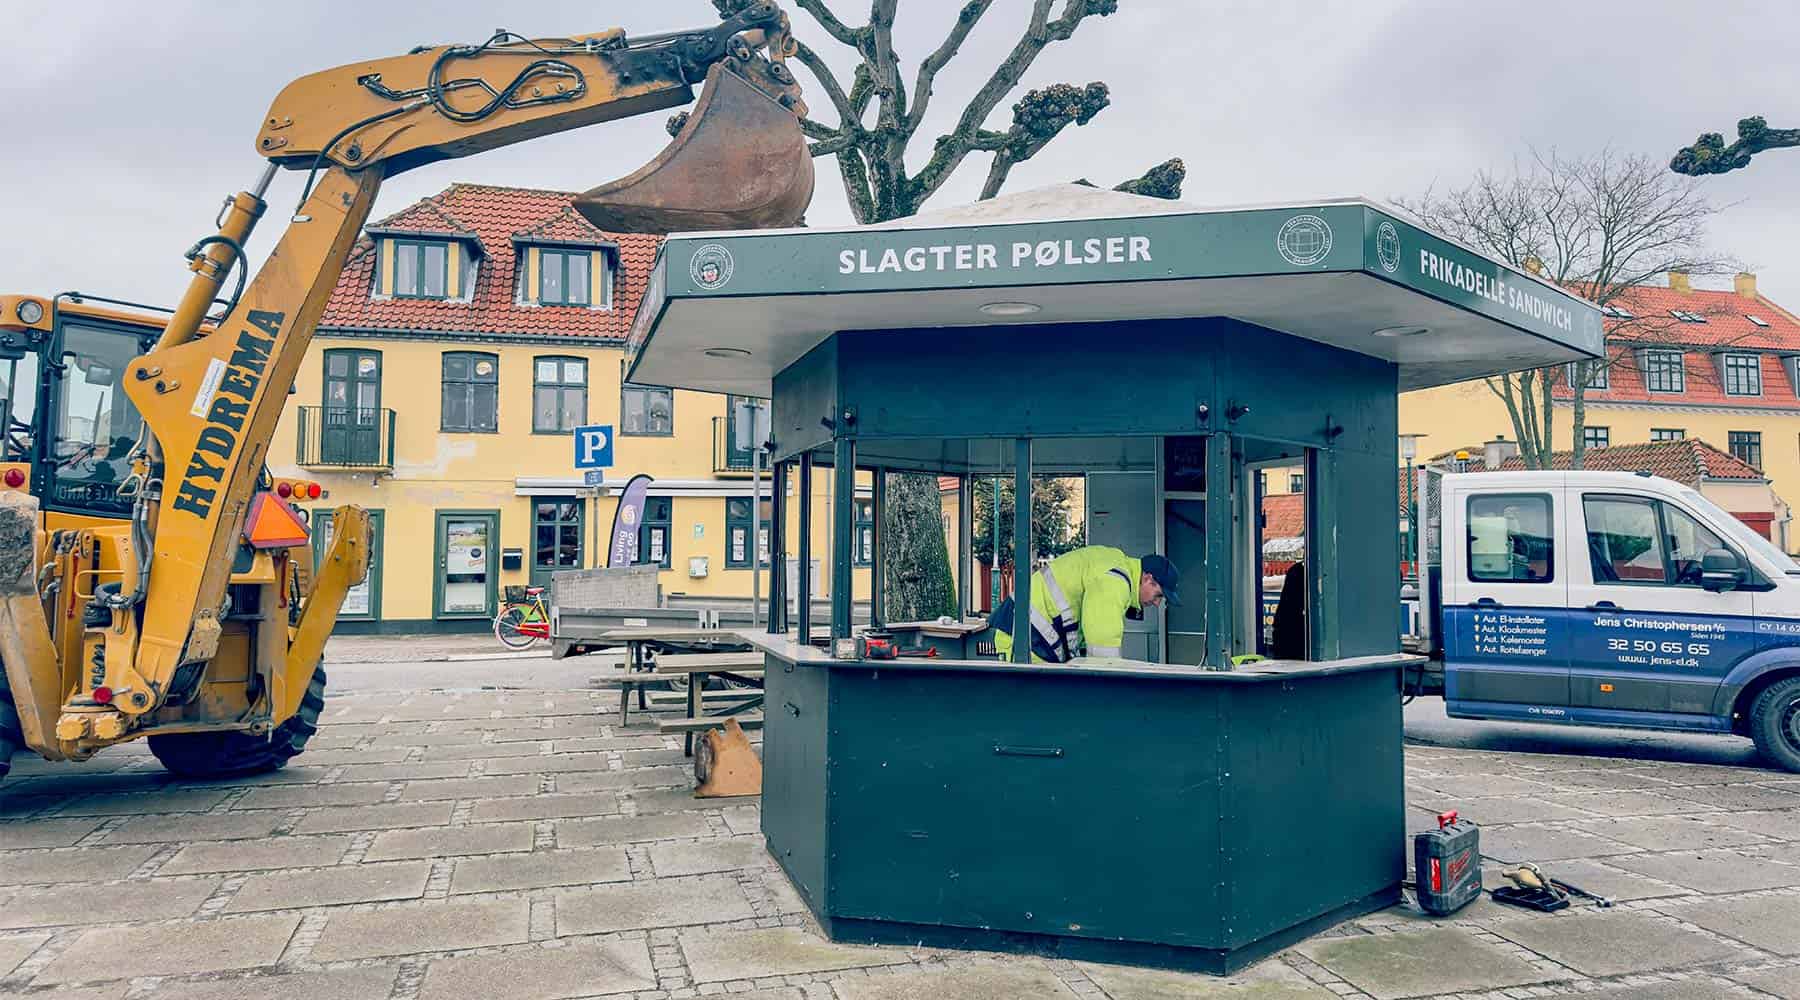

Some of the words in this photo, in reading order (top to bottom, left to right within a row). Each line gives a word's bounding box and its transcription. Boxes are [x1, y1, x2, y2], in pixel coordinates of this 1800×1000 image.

[839, 243, 998, 274] SLAGTER
[1012, 235, 1152, 267] PØLSER
[1420, 248, 1505, 305] FRIKADELLE
[1508, 287, 1572, 331] SANDWICH
[173, 309, 285, 520] HYDREMA
[581, 431, 607, 464] P
[615, 531, 629, 563] Living
[1593, 616, 1621, 628] Jens
[1623, 617, 1712, 633] Christophersen
[1759, 623, 1772, 631] CY
[1776, 623, 1786, 631] 14
[1607, 638, 1629, 651] 32
[1633, 640, 1656, 652] 50
[1660, 641, 1683, 654] 65
[1687, 643, 1710, 656] 65
